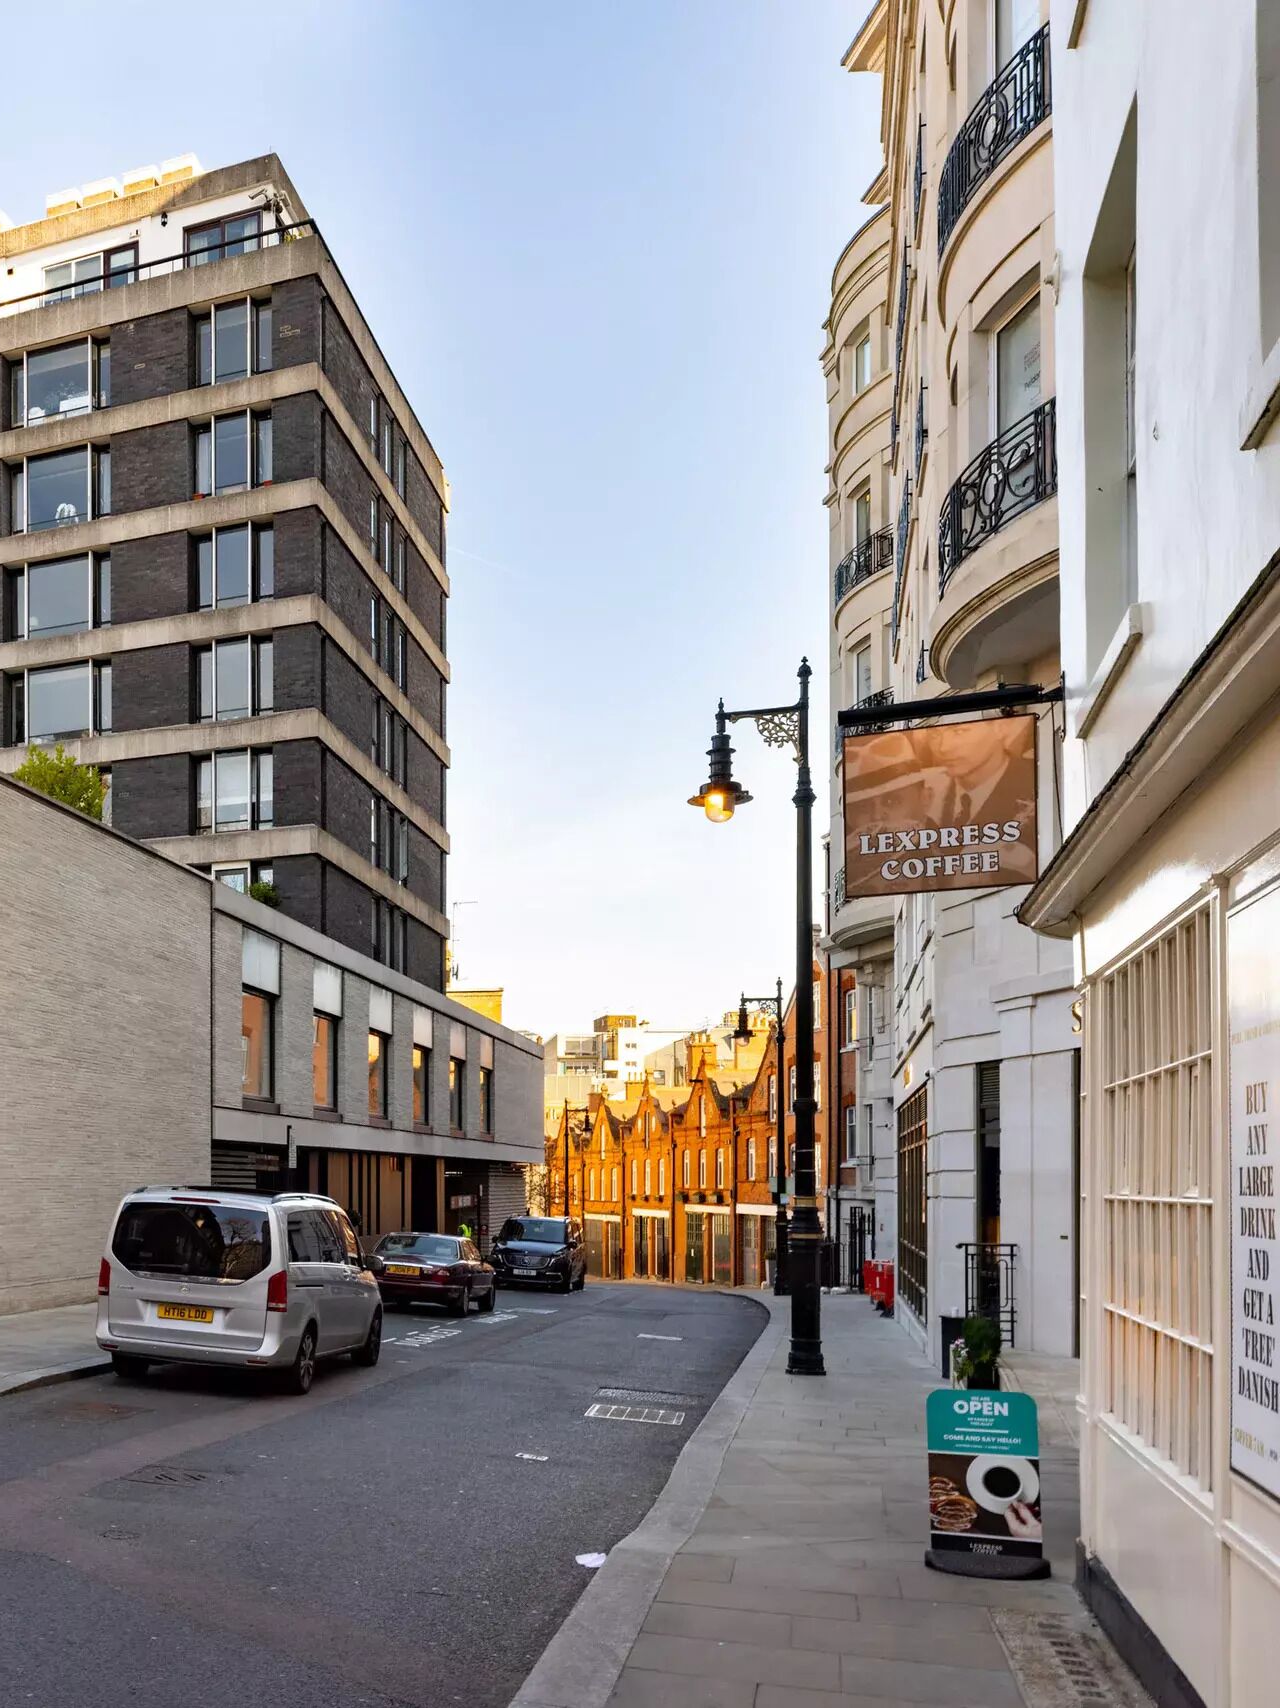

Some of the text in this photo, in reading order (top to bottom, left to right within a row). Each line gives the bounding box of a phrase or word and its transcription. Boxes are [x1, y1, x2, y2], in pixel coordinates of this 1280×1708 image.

[859, 820, 1022, 855] LEXPRESS
[880, 851, 1000, 881] COFFEE
[1246, 1081, 1268, 1115] BUY
[1246, 1124, 1268, 1155] ANY
[1239, 1166, 1274, 1197] LARGE
[1240, 1207, 1276, 1240] DRINK
[1247, 1248, 1269, 1281] AND
[1243, 1288, 1274, 1325] GET A
[1239, 1366, 1279, 1414] DANISH
[953, 1400, 1009, 1416] OPEN
